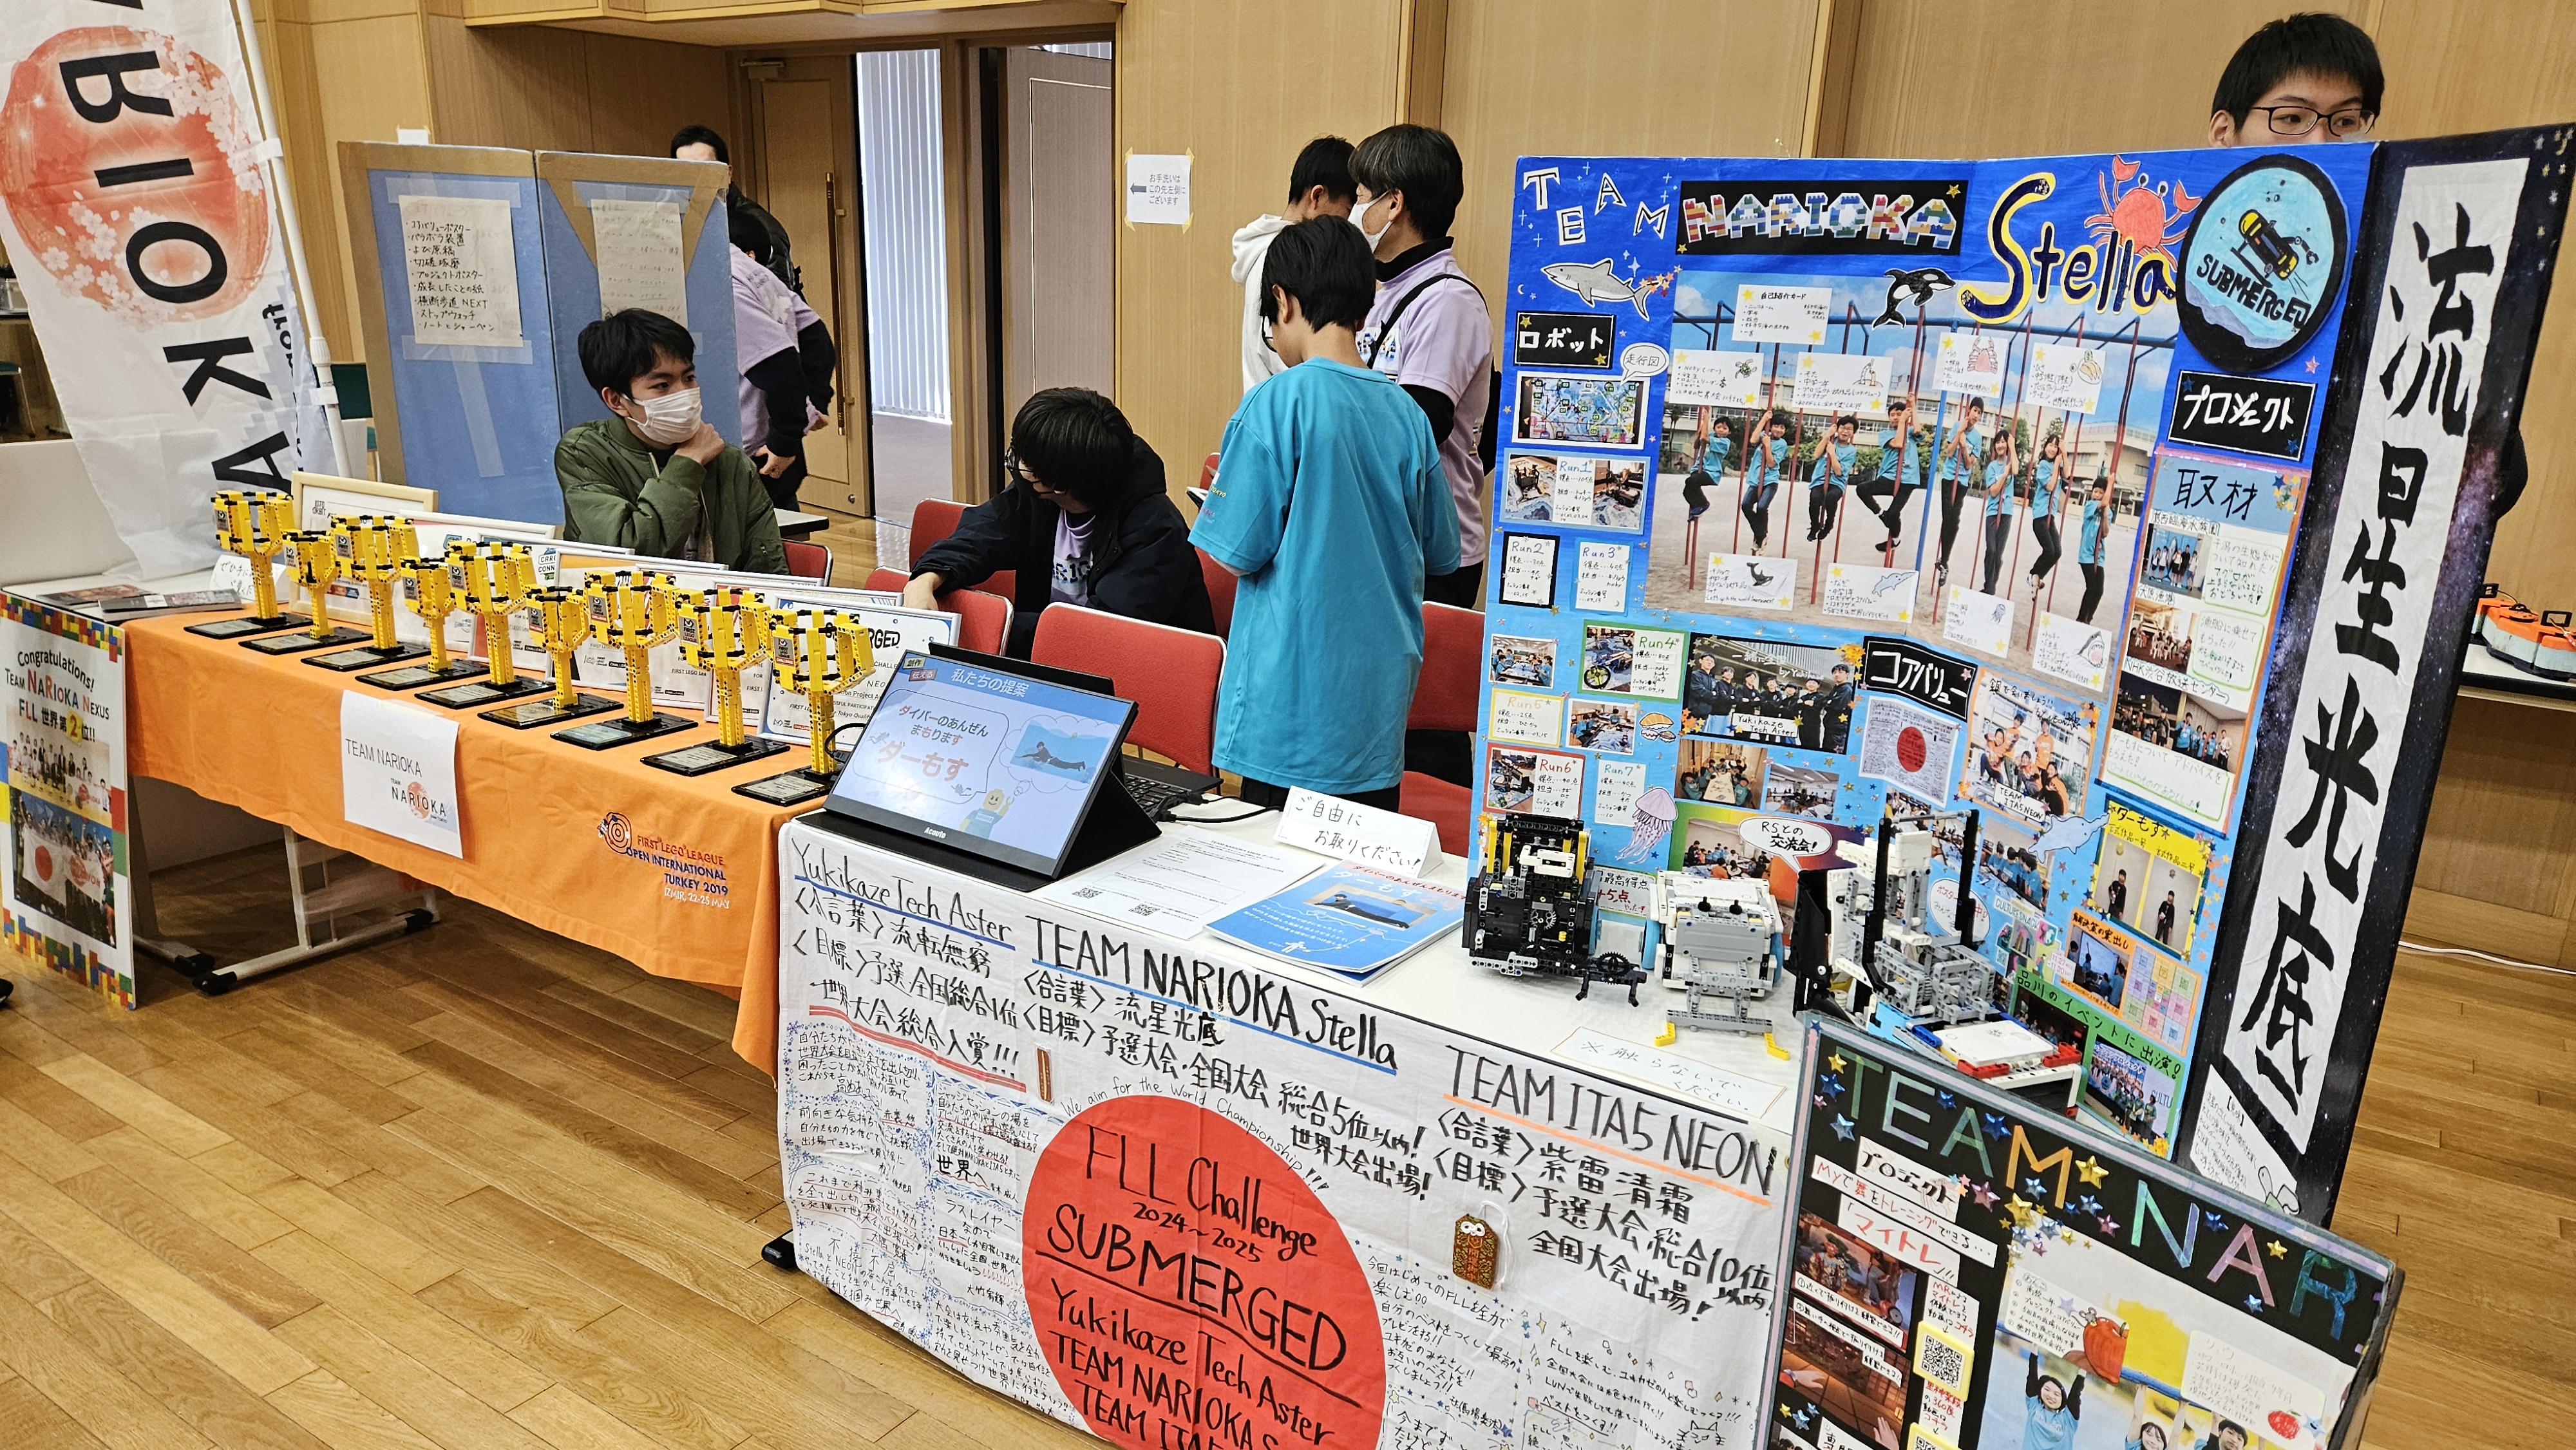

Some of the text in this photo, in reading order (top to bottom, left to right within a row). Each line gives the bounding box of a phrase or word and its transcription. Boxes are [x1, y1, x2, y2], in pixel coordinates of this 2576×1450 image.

[1150, 174, 1180, 183] お手洗いは
[1150, 185, 1186, 194] この先左側に
[1150, 196, 1179, 205] ございます
[1523, 167, 2177, 324] TEAM NARIOKA Stella
[462, 299, 488, 308] NEXT
[2197, 254, 2311, 329] SUBMERGED
[1519, 326, 1604, 353] ロボット
[2184, 384, 2295, 433] プロジェクト
[2173, 469, 2259, 521] 取材
[18, 650, 95, 693] Congratulations!
[907, 658, 923, 668] 創作
[1871, 650, 1968, 706] コアバリュー
[853, 691, 874, 701] Project
[951, 668, 1030, 699] 私たちの提案
[19, 698, 38, 723] FLL
[899, 704, 989, 737] ダイバーのあんぜん
[1738, 715, 1785, 728] Yukikaze
[910, 724, 963, 746] まもります
[1750, 725, 1795, 737] Tech Aster
[346, 738, 422, 777] TEAM NARIOKA
[878, 740, 969, 782] ダーもす
[392, 786, 446, 816] NARIOKA
[1294, 795, 1361, 827] ご自由に
[2000, 787, 2022, 802] TEAM
[2023, 807, 2044, 821] NEON
[626, 847, 727, 881] OPEN INTERNATIONAL
[687, 849, 725, 866] LEAGUE
[1314, 828, 1422, 871] お取りください!
[664, 872, 729, 896] TURKEY 2019
[688, 892, 710, 905] 22-25
[712, 898, 730, 909] MAY
[791, 838, 1012, 943] Yukikaze Tech Aster
[1331, 871, 1423, 898] ダーもす
[1026, 914, 1397, 1070] TEAM NARIOKA Stella
[1062, 1100, 1084, 1118] We
[1088, 1090, 1110, 1106] aim
[1112, 1077, 1134, 1095] for
[1141, 1077, 1163, 1094] the
[1170, 1082, 1208, 1106] World
[1444, 1044, 1555, 1123] TEAM
[1664, 1114, 1779, 1196] NEON
[1835, 1046, 2073, 1210] TEAM
[936, 1154, 988, 1187] 世界へ
[1291, 1124, 1434, 1200] 世界大会出場!
[1861, 1149, 1958, 1205] プロジェクト
[1085, 1124, 1318, 1263] FLL Challenge
[947, 1199, 1016, 1232] ラストイヤー
[1047, 1203, 1347, 1371] SUBMERGED
[1528, 1229, 1715, 1322] 全国大会出場!
[1050, 1278, 1189, 1366] Yukikaze
[1198, 1330, 1251, 1400] Tech
[1256, 1375, 1336, 1448] Aster
[1048, 1330, 1124, 1389] TEAM
[1132, 1363, 1253, 1450] NARIOKA
[1075, 1379, 1146, 1441] TEAM
